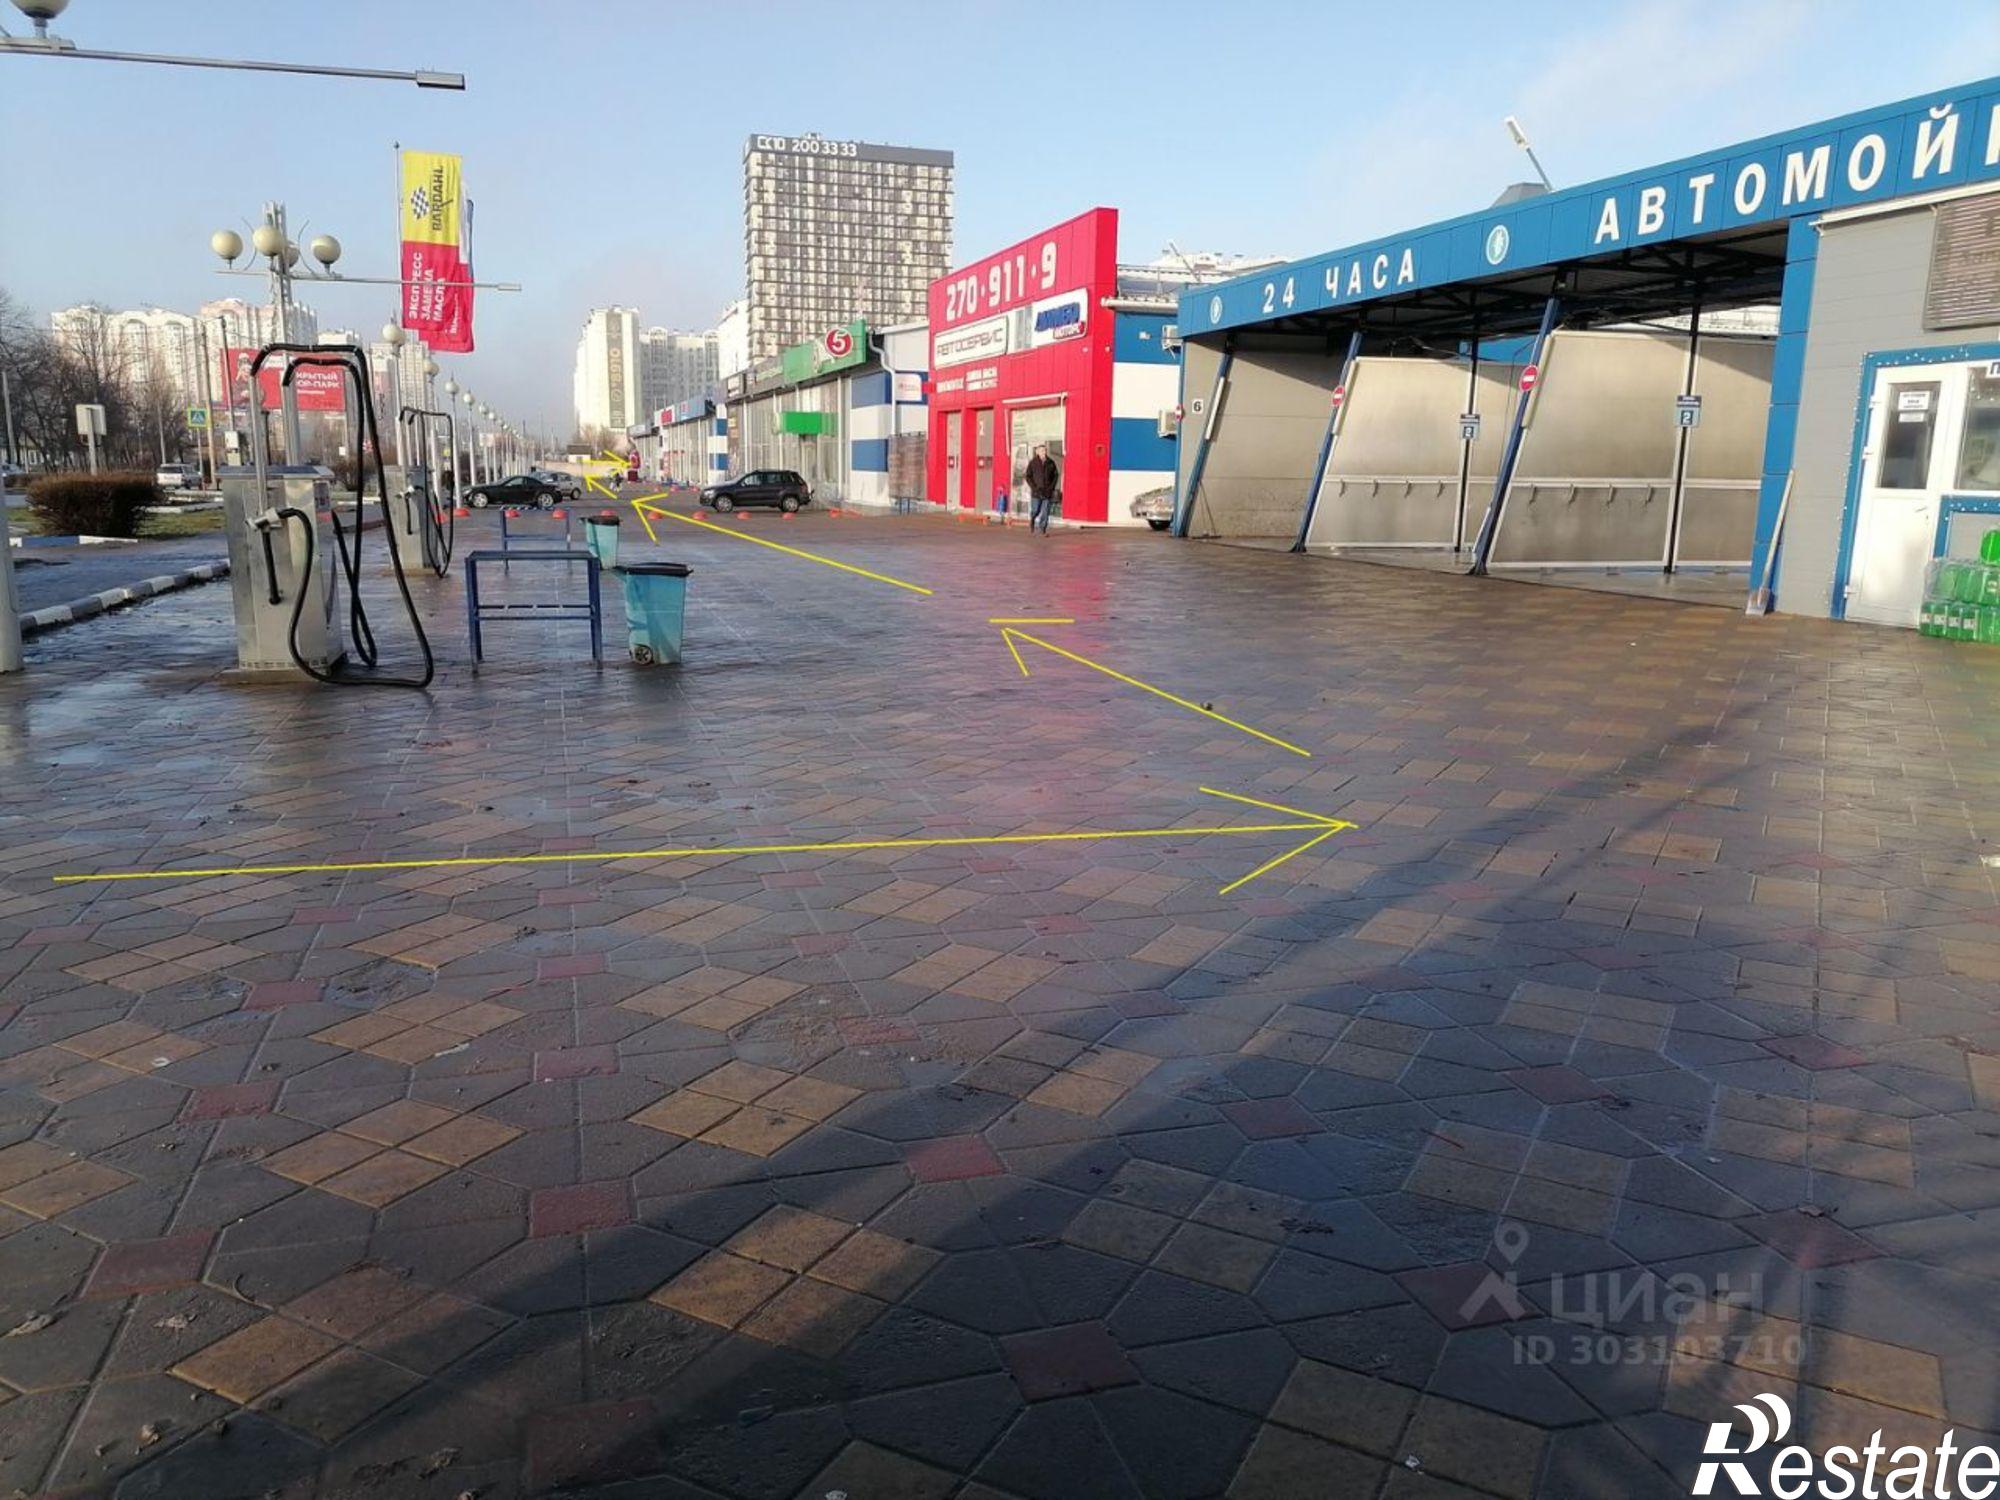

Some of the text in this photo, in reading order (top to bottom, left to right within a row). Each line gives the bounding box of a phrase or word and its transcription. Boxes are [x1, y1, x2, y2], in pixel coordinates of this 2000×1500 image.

[432, 165, 444, 231] BARDAHL
[1262, 248, 1415, 313] 24 ЧАСА
[936, 327, 1004, 356] АВТОСЕРВИС
[1193, 401, 1202, 412] 6
[1682, 411, 1692, 424] 2
